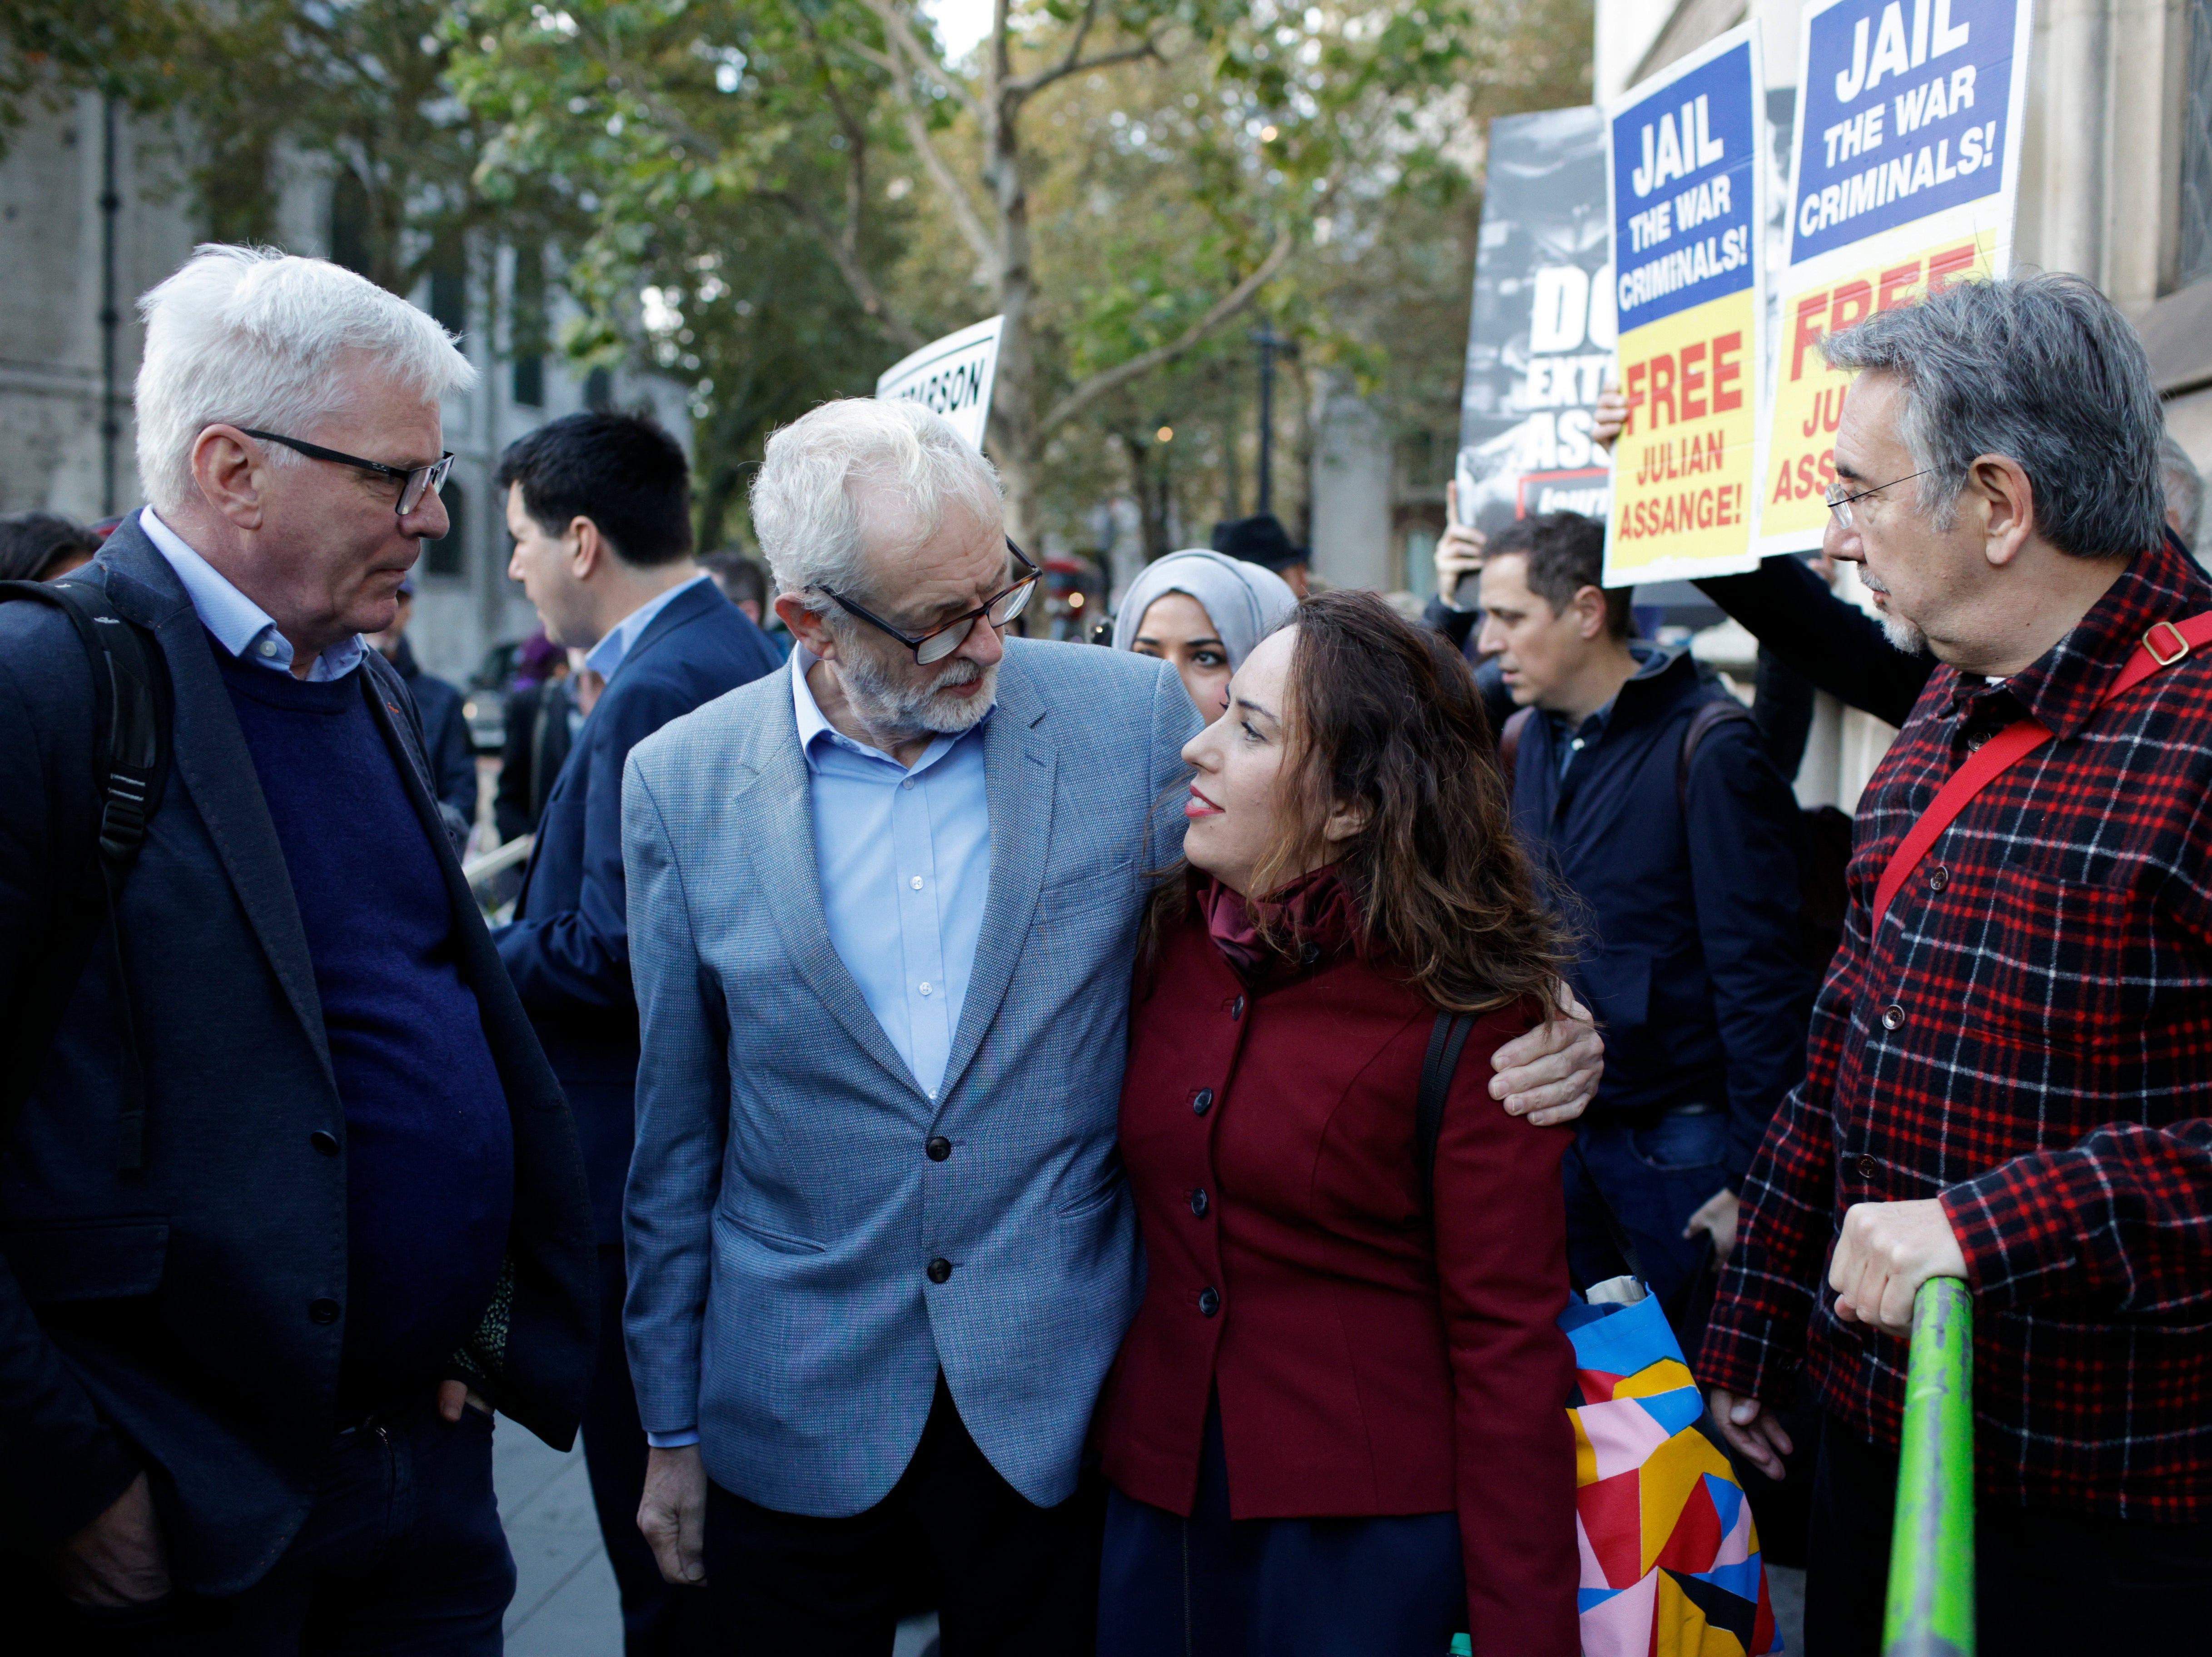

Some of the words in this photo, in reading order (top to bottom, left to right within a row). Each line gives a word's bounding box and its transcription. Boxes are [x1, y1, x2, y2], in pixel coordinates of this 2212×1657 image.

[1836, 0, 1969, 103] JAIL
[1632, 93, 1724, 198] JAIL
[1824, 103, 1885, 169] THE
[1894, 64, 1976, 137] WAR
[1628, 201, 1671, 254] THE
[1675, 174, 1731, 233] WAR
[1799, 120, 1996, 238] CRIMINALS!
[1618, 224, 1748, 312] CRIMINALS!
[1627, 330, 1742, 436] FREE
[1637, 429, 1724, 486] JULIAN
[1619, 482, 1742, 541] ASSANGE!
